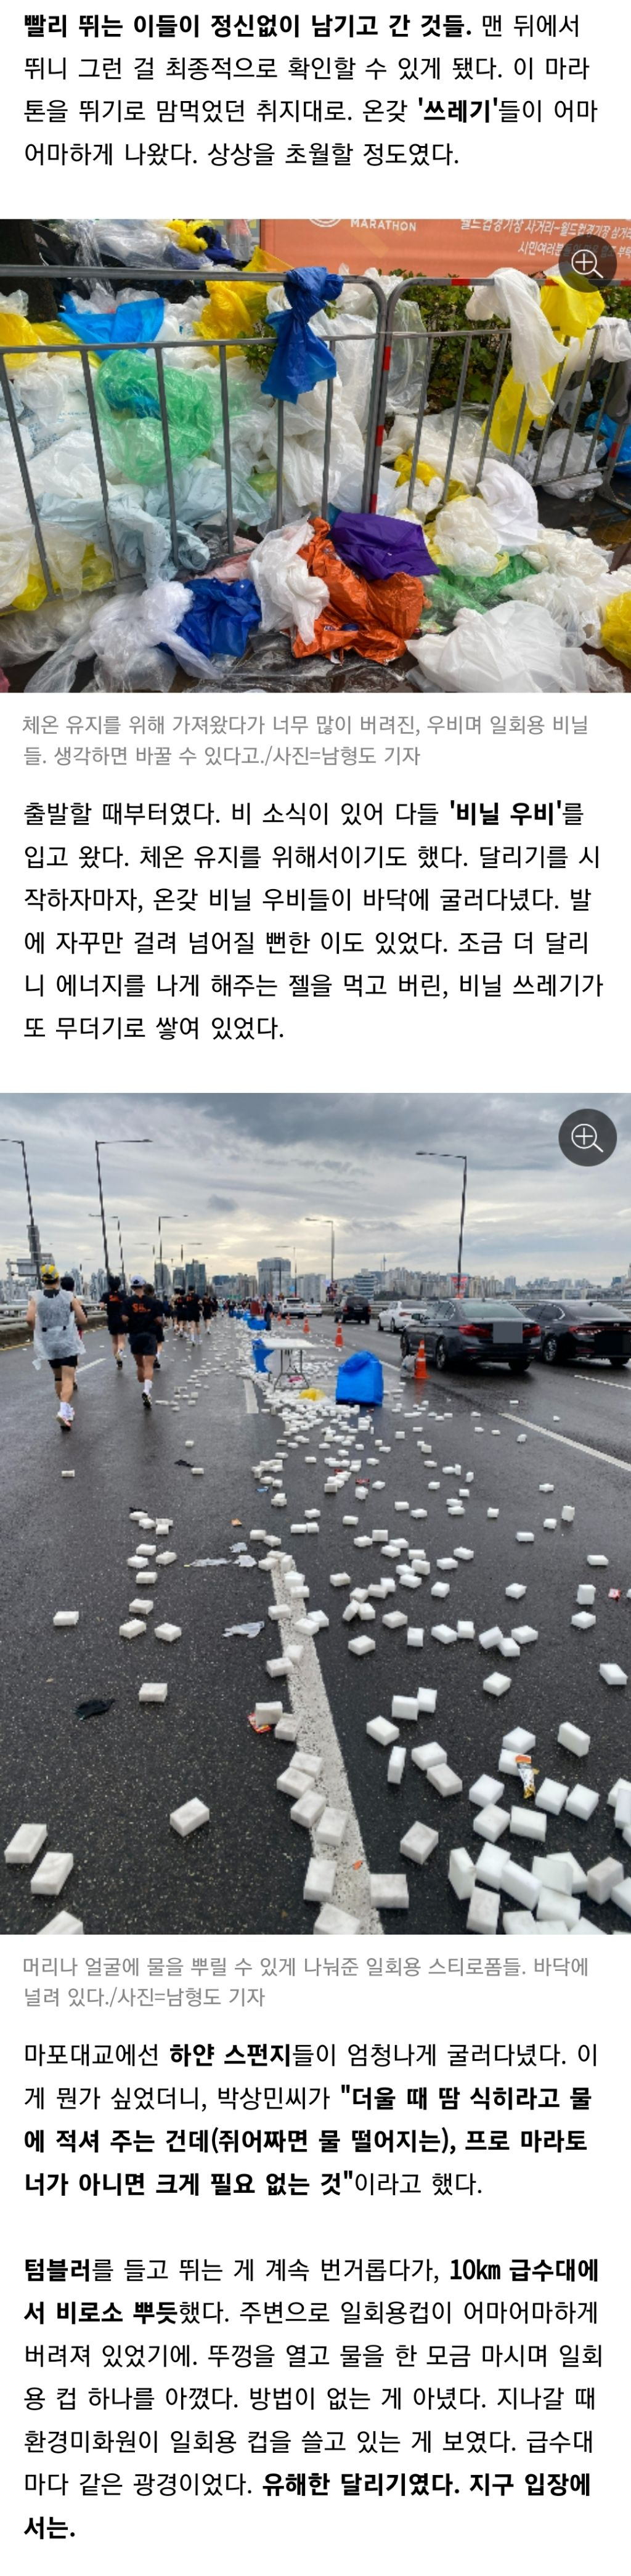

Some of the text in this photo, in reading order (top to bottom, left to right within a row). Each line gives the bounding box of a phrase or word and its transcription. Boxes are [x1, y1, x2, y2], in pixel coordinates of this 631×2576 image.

[24, 14, 579, 38] 빨리 뛰는 이들이 정신없이 남기고 간 것들. 맨 뒤에서
[23, 97, 598, 123] 톤을 뛰기로 맘먹었던 취지대로. 온갖 '쓰레기'들이 어마
[25, 142, 459, 167] 어마하게 나왔다. 상상을 초월할 정도였다.
[350, 219, 417, 232] MARATHON
[22, 715, 587, 736] 체온 유지를 위해 가져왔다가 너무 많이 버려진, 우비며 일회용 비닐
[23, 746, 421, 766] 들. 생각하면 바꿀 수 있다고./사진=남형도 기자
[23, 800, 584, 826] 출발할 때부터였다. 비 소식이 있어 다들 '비닐 우비'를
[24, 845, 599, 869] 입고 왔다. 체온 유지를 위해서이기도 했다. 달리기를 시
[24, 888, 592, 914] 작하자마자, 온갖 비닐 우비들이 바닥에 굴러다녔다. 발
[25, 973, 604, 999] 니 에너지를 나게 해주는 젤을 먹고 버린, 비닐 쓰레기가
[23, 1957, 588, 1977] 머리나 얼굴에 물을 뿌릴 수 있게 나눠준 일회용 스티로폼들. 바닥에
[25, 1986, 266, 2007] 널려 있다./사진=남형도 기자
[25, 2043, 596, 2068] 마포대교에선 하얀 스펀지들이 엄청나게 굴러다녔다. 이
[24, 2084, 592, 2113] 게 뭔가 싶었더니, 박상민씨가 "더울 때 땀 식히라고 물
[24, 2126, 587, 2155] 에 적셔 주는 건데(쥐어짜면 물 떨어지는), 프로 마라토
[25, 2170, 482, 2196] 너가 아니면 크게 필요 없는 것"이라고 했다.
[25, 2258, 114, 2282] 텀블러를
[124, 2259, 169, 2282] 들고
[179, 2258, 223, 2282] 뛰는
[234, 2258, 254, 2282] 게
[266, 2258, 310, 2282] 계속
[321, 2258, 439, 2284] 번거롭다가,
[509, 2258, 598, 2282] 급수대에
[23, 2301, 597, 2325] 서 비로소 뿌듯했다. 주변으로 일회용컵이 어마어마하게
[24, 2430, 592, 2454] 환경미화원이 일회용 컵을 쓸고 있는 게 보였다. 급수대
[25, 2472, 590, 2497] 마다 같은 광경이었다. 유해한 달리기였다. 지구 입장에
[23, 2516, 75, 2540] 서는.
